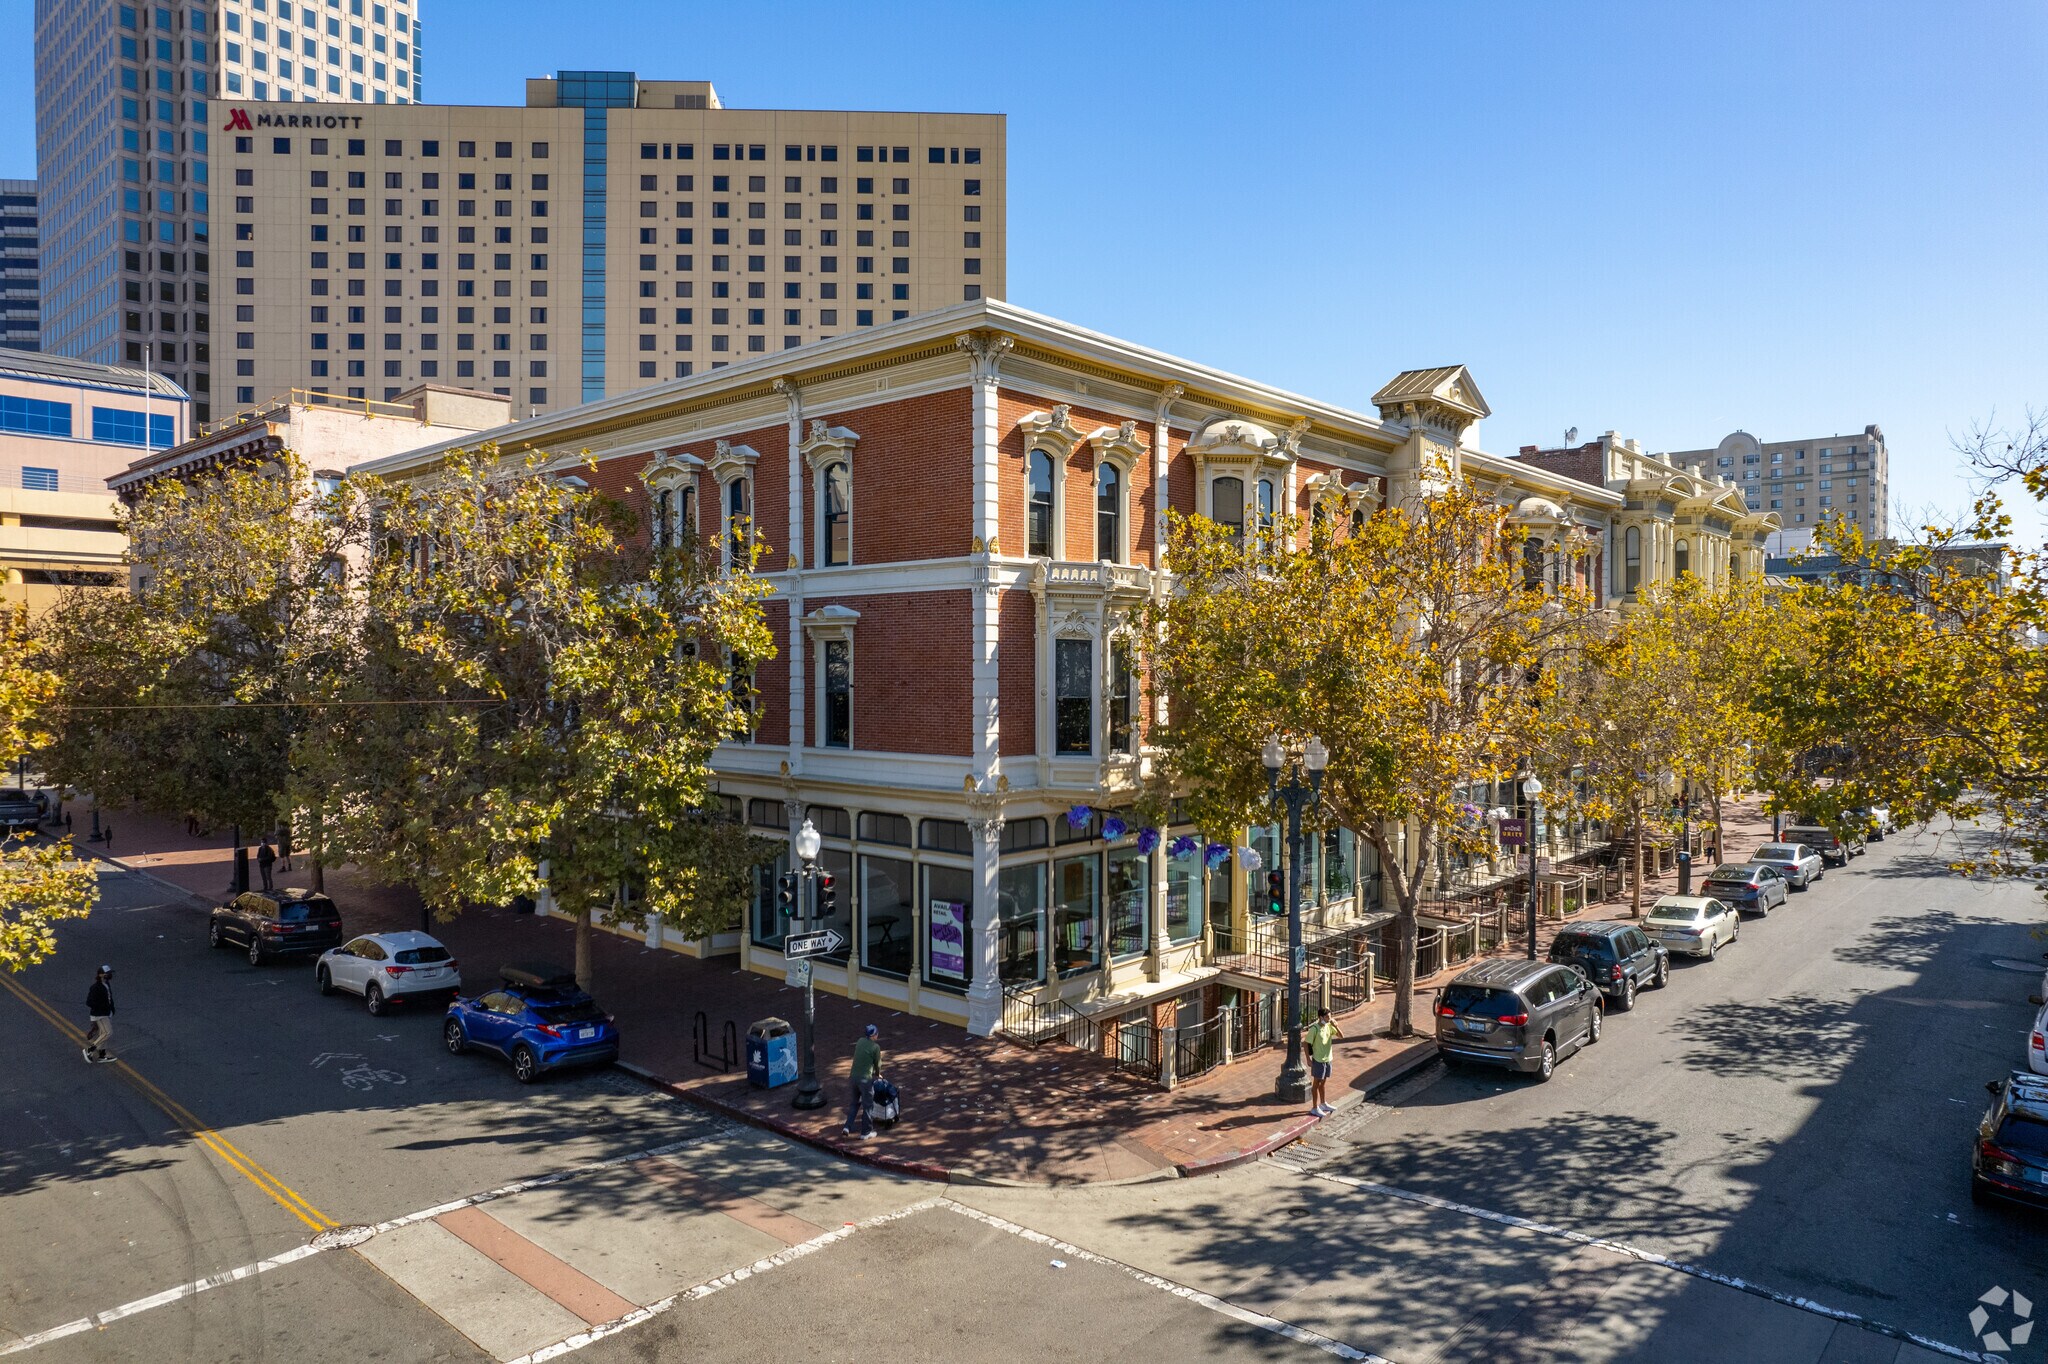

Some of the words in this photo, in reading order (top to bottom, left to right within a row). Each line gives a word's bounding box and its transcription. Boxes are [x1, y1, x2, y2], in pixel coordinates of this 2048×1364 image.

[257, 114, 362, 129] MARRIOTT
[792, 941, 808, 951] ONE
[810, 937, 827, 948] WAY
